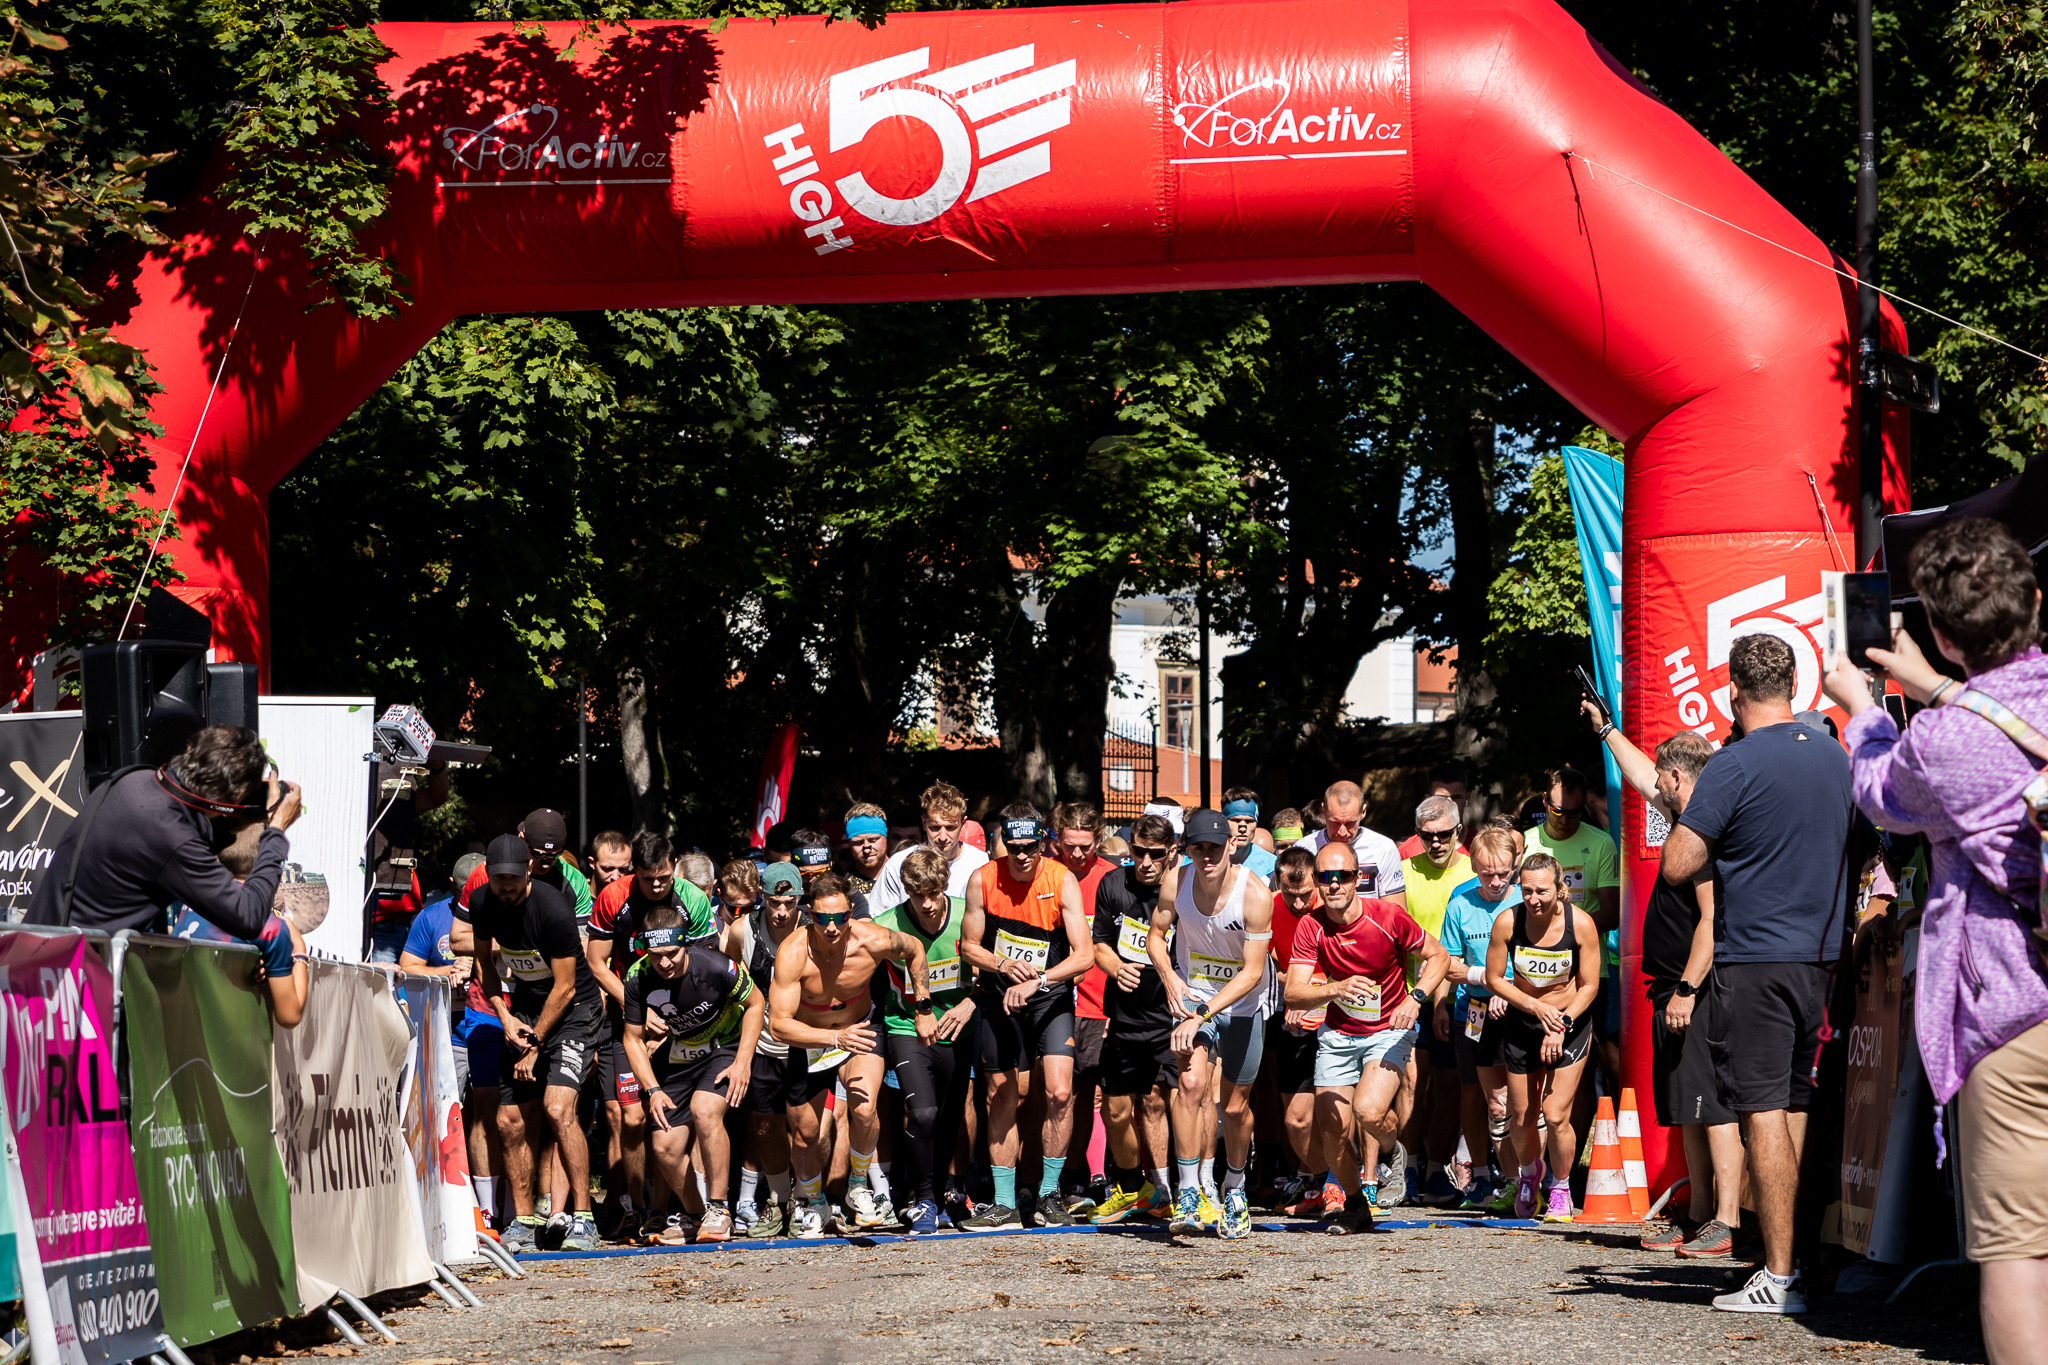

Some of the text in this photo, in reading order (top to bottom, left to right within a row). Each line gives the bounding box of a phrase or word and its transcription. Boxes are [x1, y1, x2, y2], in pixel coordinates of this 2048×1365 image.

[1208, 107, 1402, 147] ForActiv.cz
[763, 46, 972, 256] HIGH 5
[1131, 932, 1147, 948] 16
[1006, 945, 1034, 963] 176
[510, 958, 535, 970] 179
[1203, 963, 1233, 978] 170
[1528, 960, 1558, 974] 204
[928, 969, 946, 980] 41
[680, 1048, 708, 1059] 159
[620, 1084, 639, 1093] APER
[309, 1086, 377, 1194] Fitmin
[164, 1136, 247, 1207] RYCHNOVÁCI
[78, 1287, 160, 1343] 800 400 900
